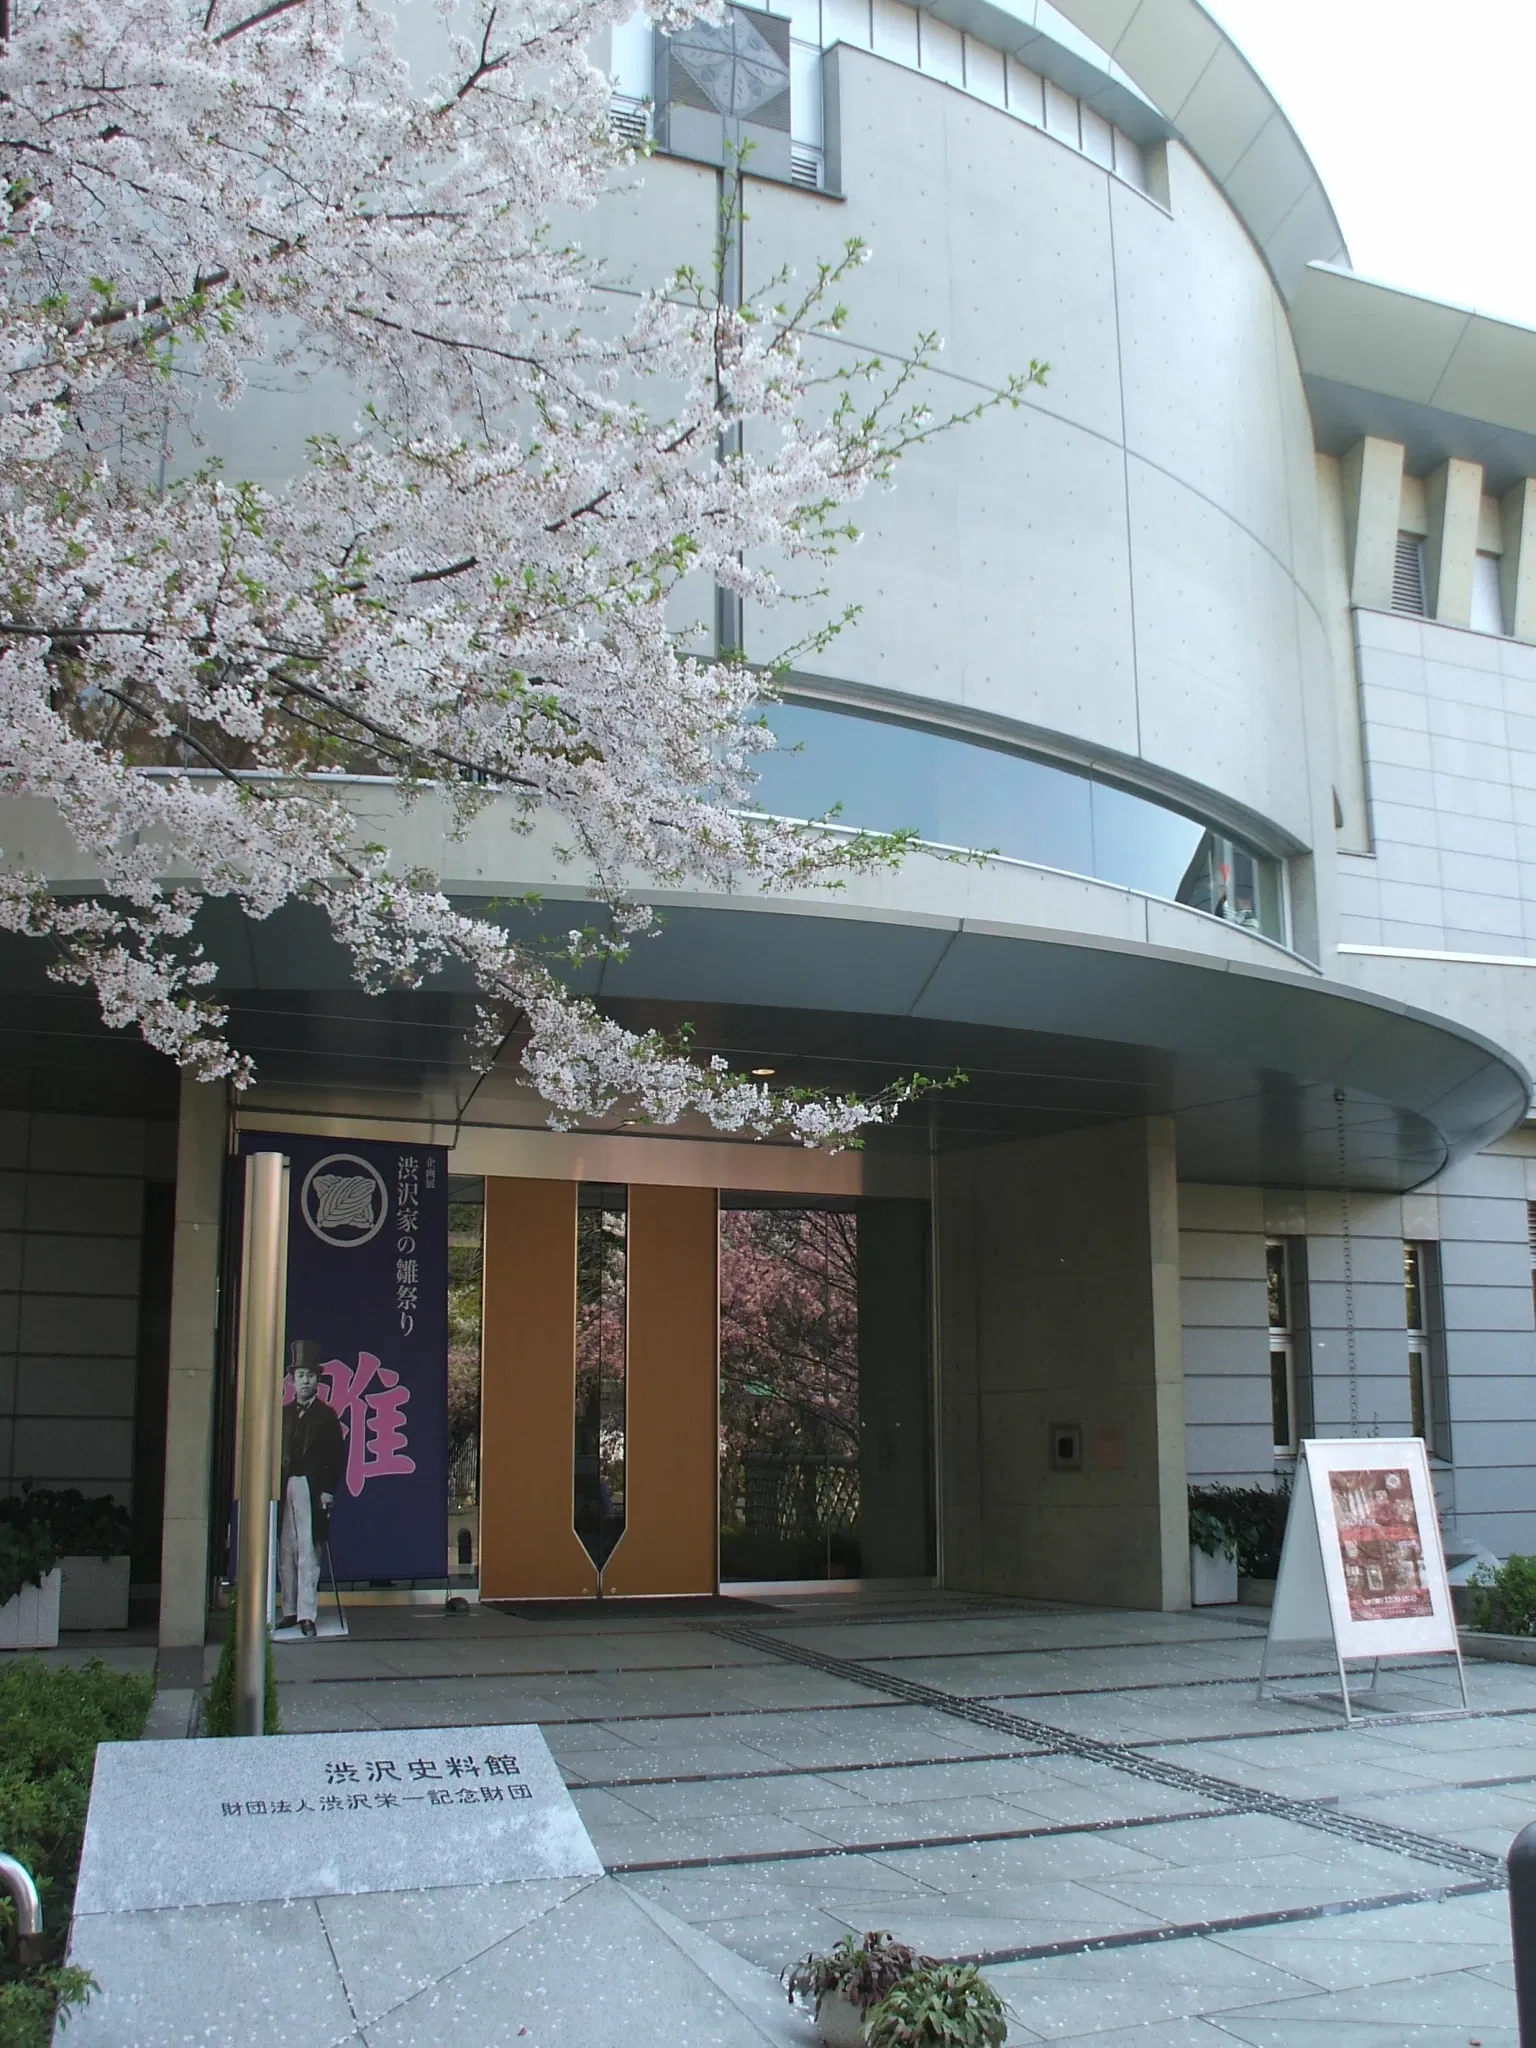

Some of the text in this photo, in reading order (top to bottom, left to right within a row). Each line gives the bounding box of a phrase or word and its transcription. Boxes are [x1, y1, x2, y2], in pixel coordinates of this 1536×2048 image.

[426, 1156, 436, 1189] 企画展
[396, 1155, 420, 1337] 渋沢家の雛祭り
[325, 1754, 521, 1784] 渋沢史料館
